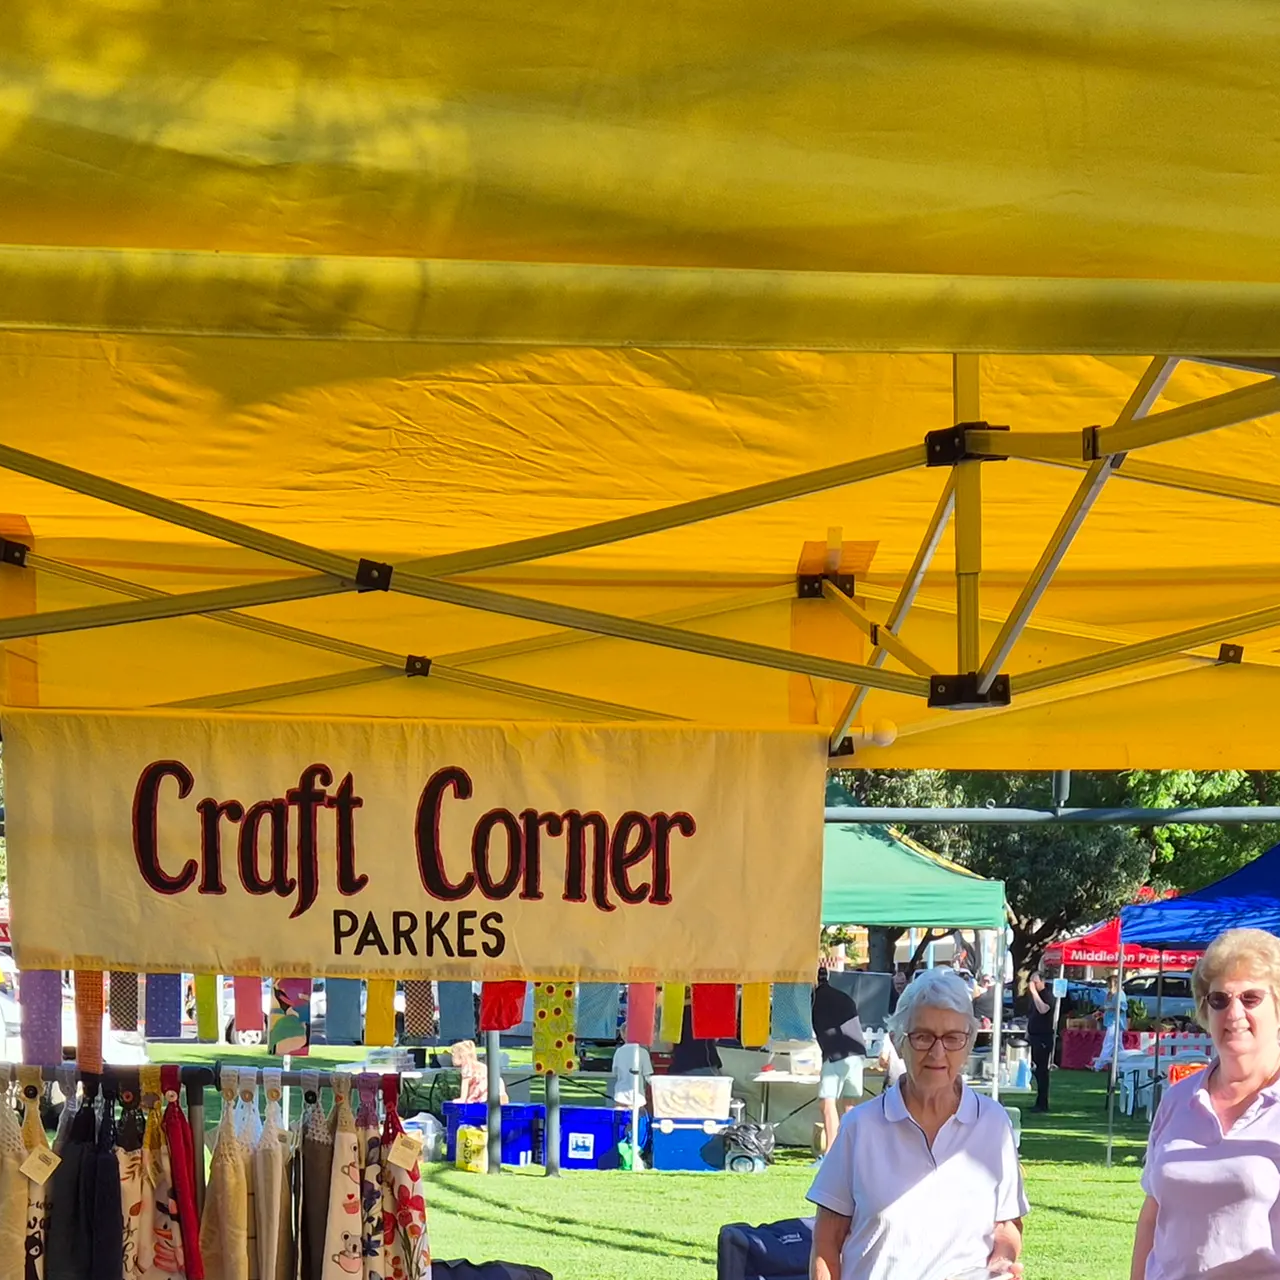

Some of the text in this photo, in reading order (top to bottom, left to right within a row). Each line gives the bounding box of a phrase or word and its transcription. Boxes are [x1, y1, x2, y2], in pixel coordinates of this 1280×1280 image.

[131, 758, 698, 920] Craft Corner
[332, 908, 507, 959] PARKES
[1138, 953, 1178, 963] Public
